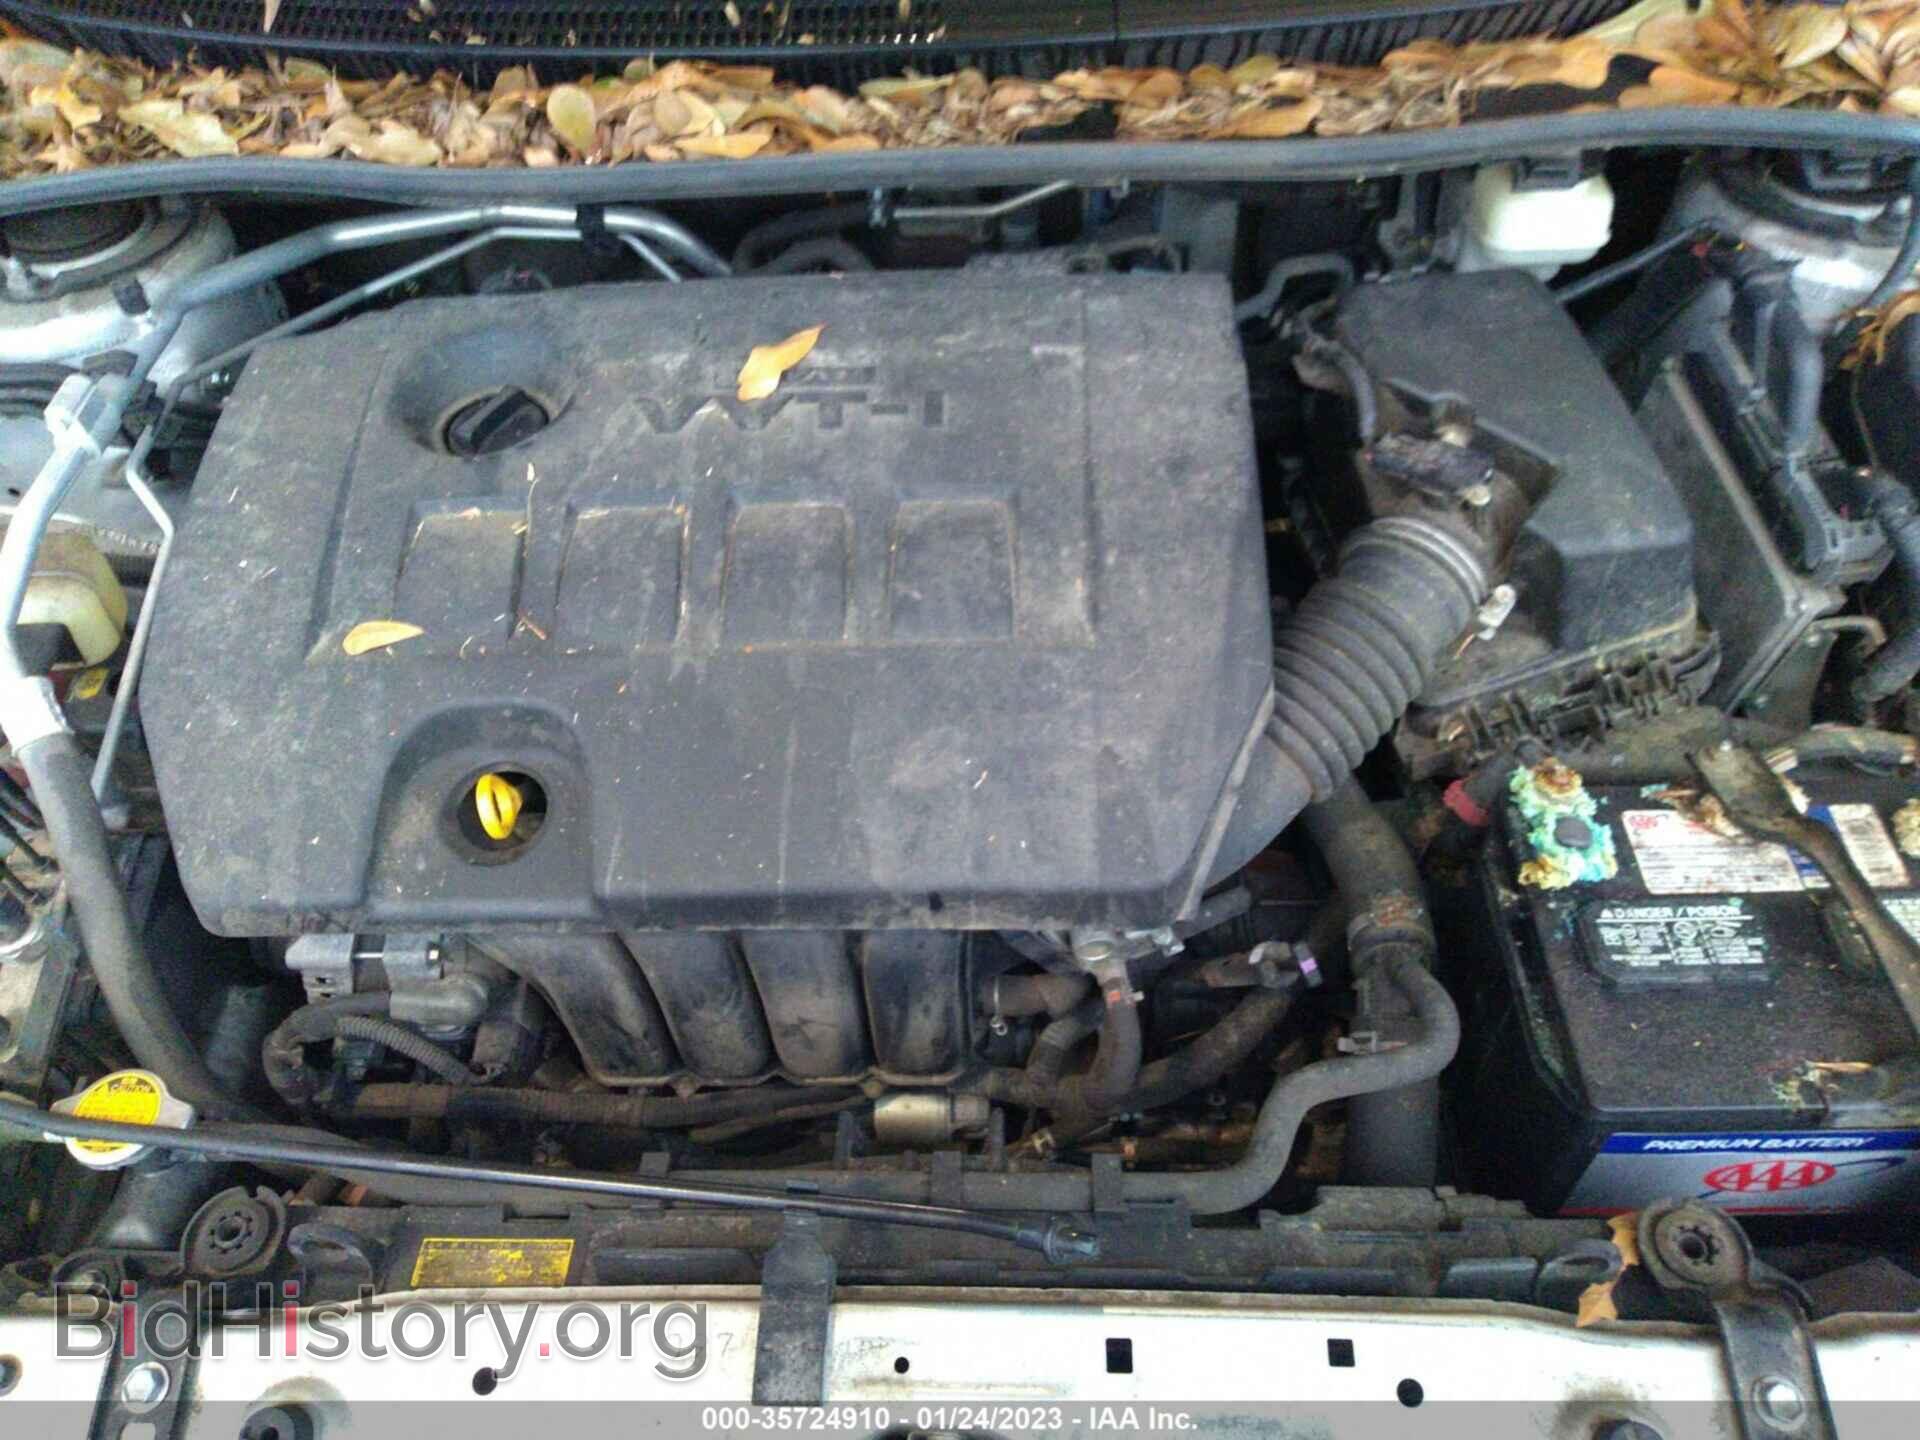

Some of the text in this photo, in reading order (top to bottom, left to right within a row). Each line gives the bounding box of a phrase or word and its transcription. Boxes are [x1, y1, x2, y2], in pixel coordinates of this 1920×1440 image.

[1643, 1136, 1876, 1150] PREMIUM BATTERY
[1710, 1159, 1830, 1192] AAA
